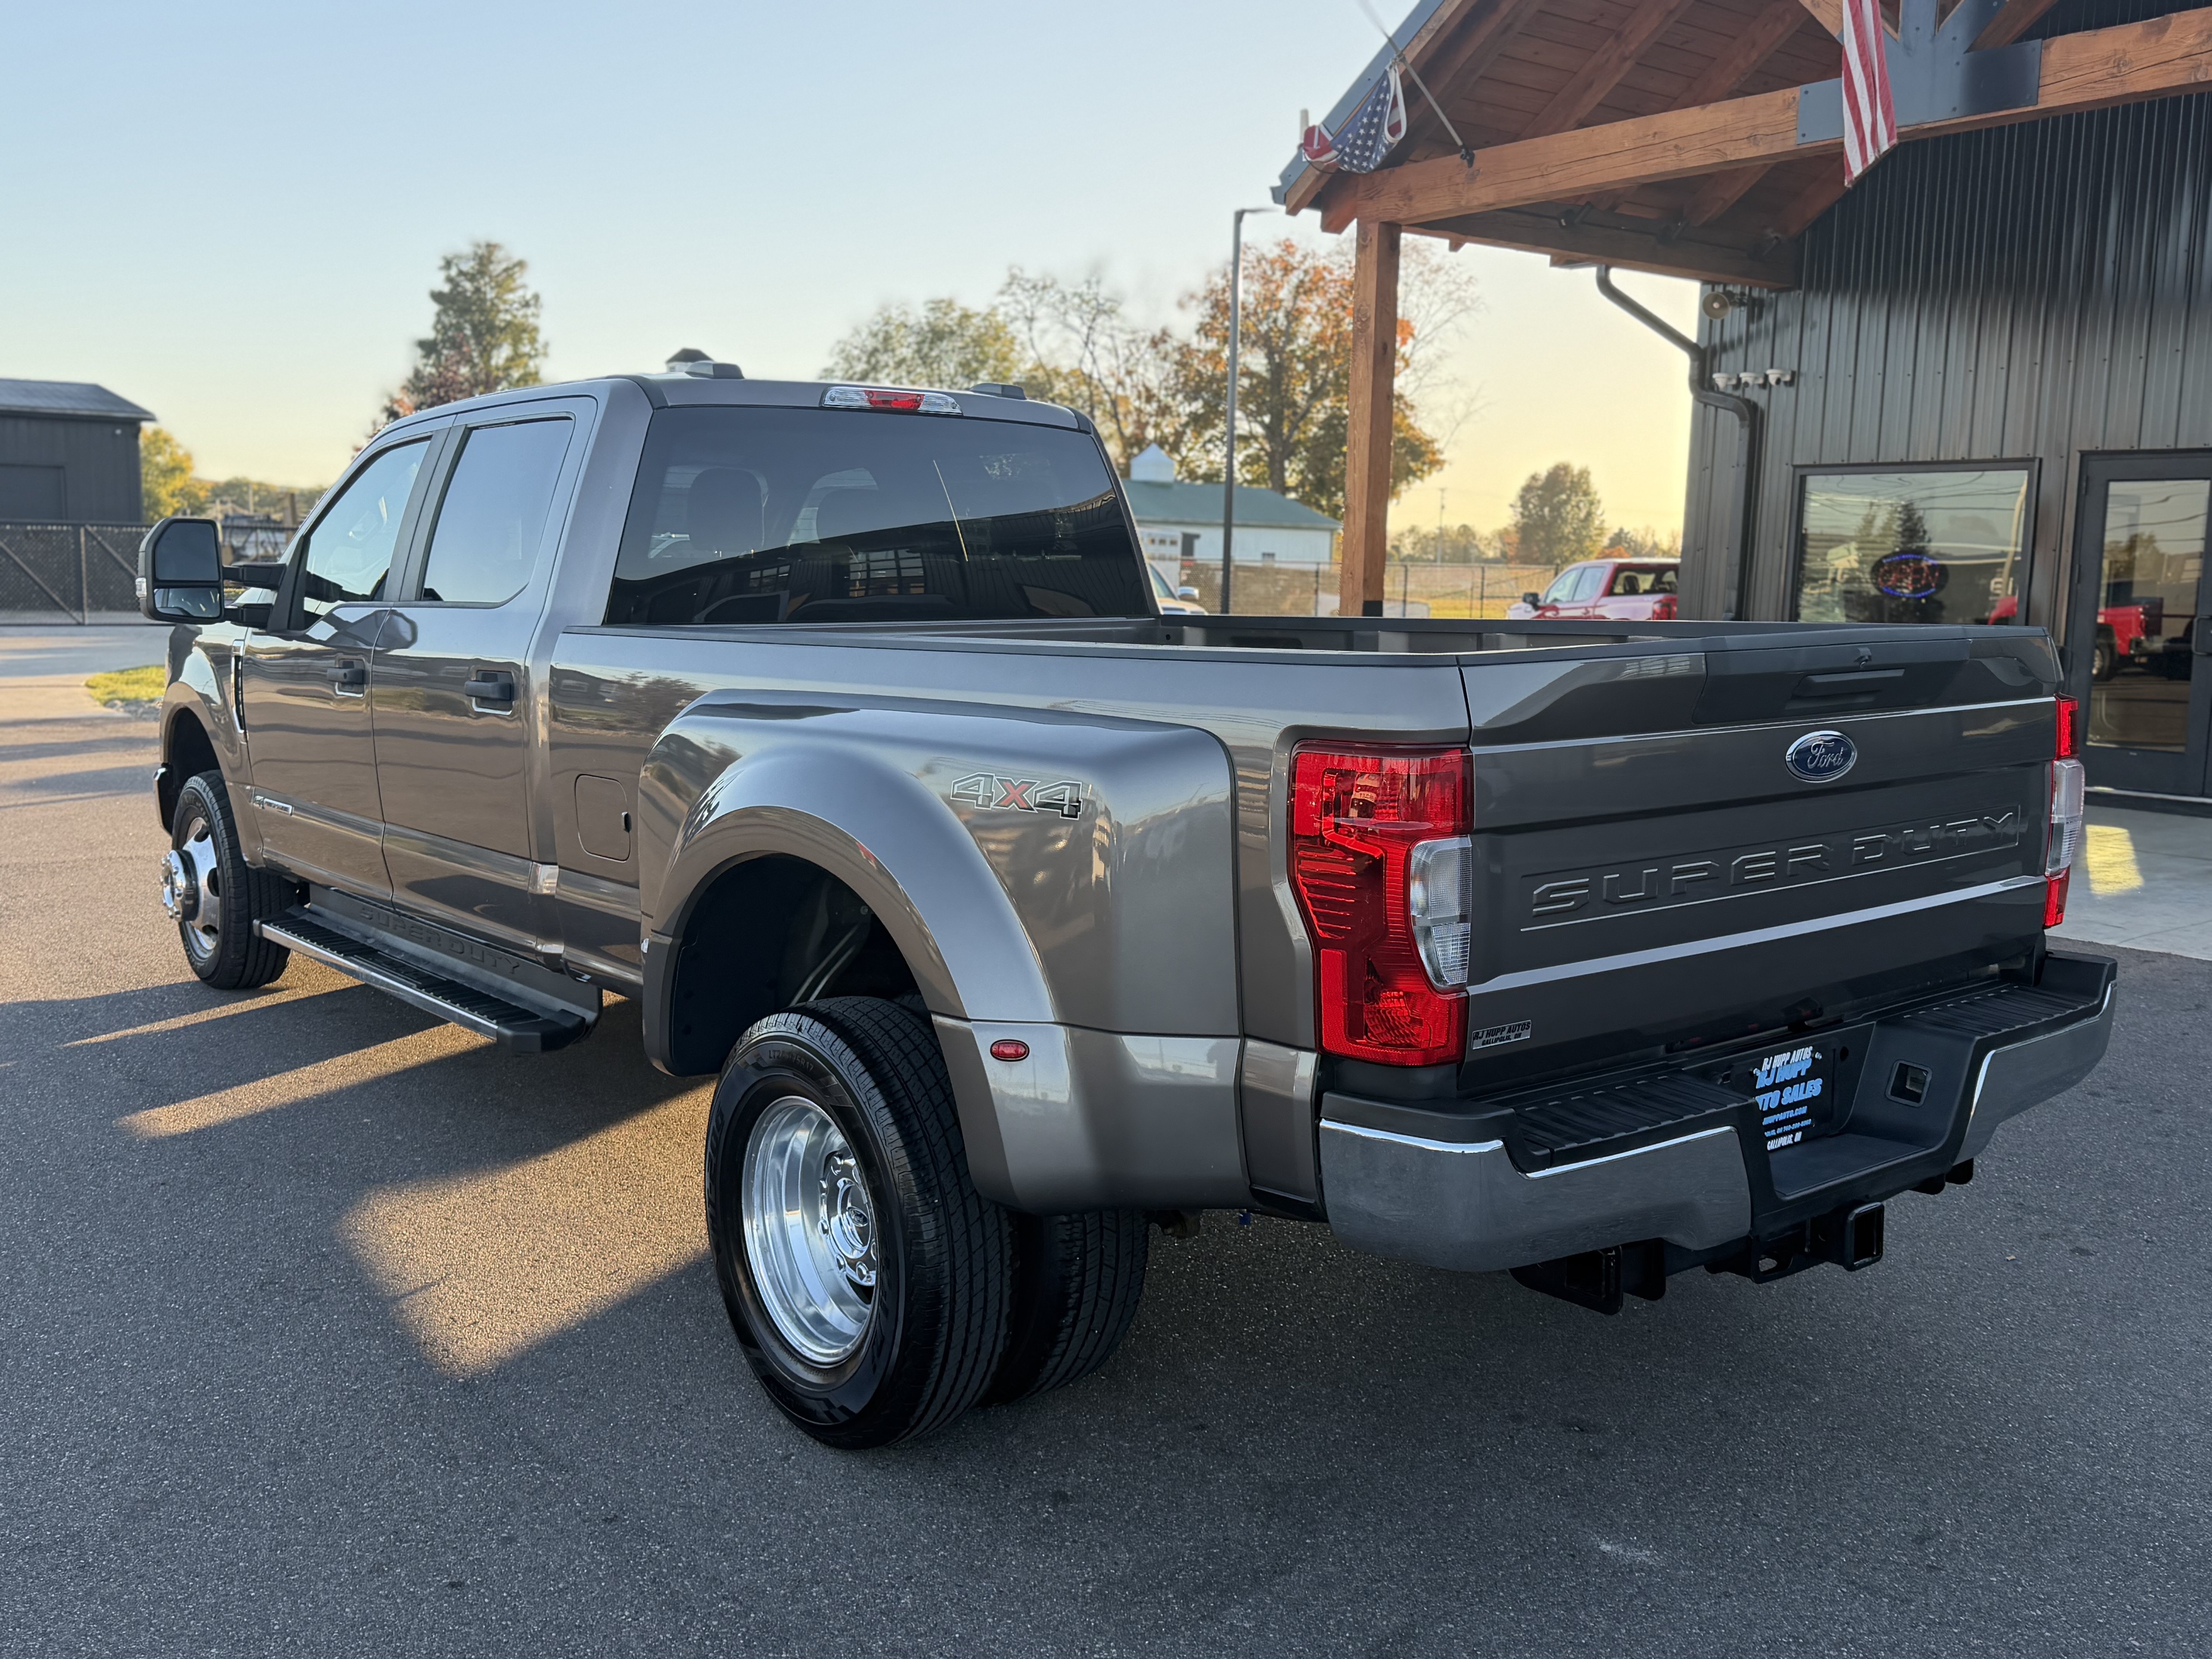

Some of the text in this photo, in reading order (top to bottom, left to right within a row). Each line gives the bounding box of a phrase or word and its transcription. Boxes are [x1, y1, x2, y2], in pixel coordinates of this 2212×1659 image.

[1878, 563, 1939, 590] OPEN
[1807, 740, 1845, 769] Ford
[1532, 812, 2013, 917] SUPER DUTY
[359, 907, 520, 975] SUPER DUTY
[1473, 1022, 1531, 1040] RJ HUPP AUTOS
[1762, 1046, 1813, 1071] RJ HUPP AUTOS
[1775, 1058, 1812, 1083] HUPP
[1781, 1078, 1823, 1105] SALES
